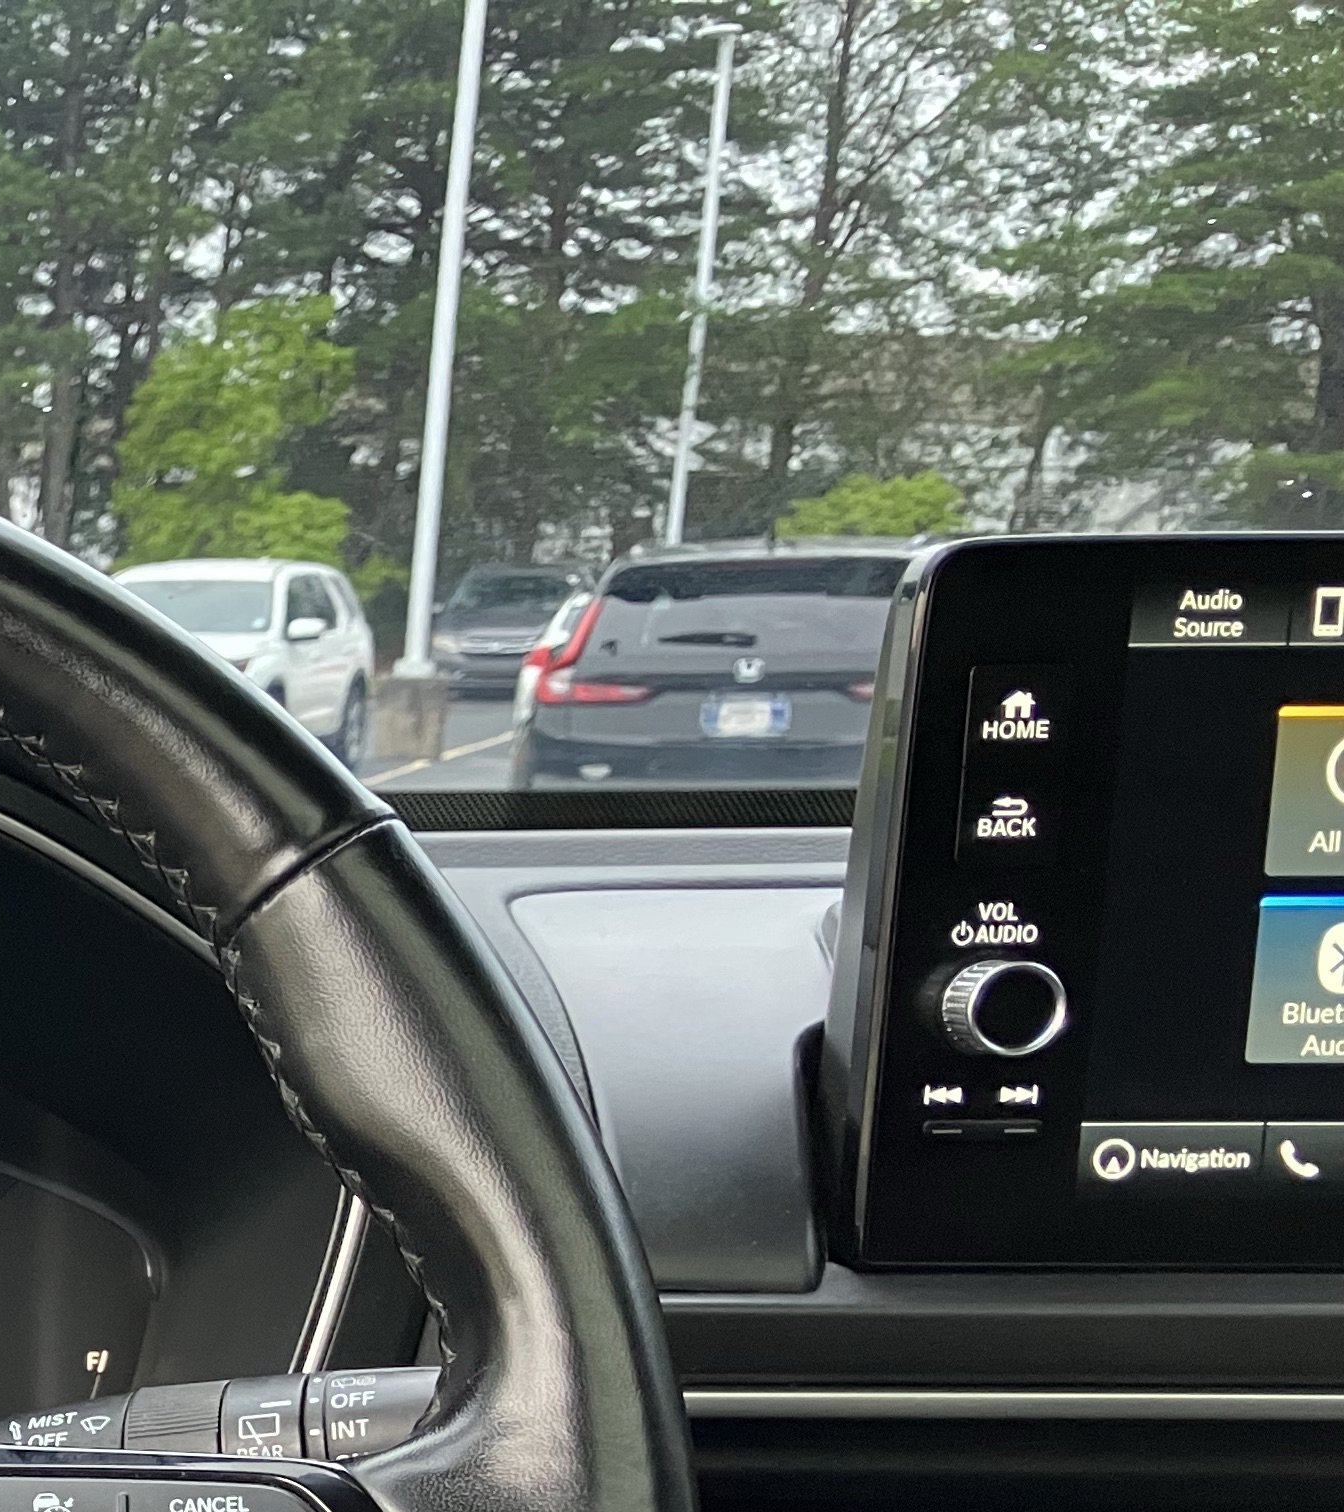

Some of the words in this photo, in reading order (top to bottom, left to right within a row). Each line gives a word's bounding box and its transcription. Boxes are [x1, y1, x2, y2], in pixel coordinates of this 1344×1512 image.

[1180, 589, 1243, 611] Audio
[1174, 616, 1244, 638] Source
[982, 719, 1050, 740] HOME
[976, 817, 1036, 838] BACK
[1309, 830, 1341, 852] All
[978, 902, 1018, 922] VOL
[975, 923, 1038, 944] AUDIO
[1141, 1149, 1250, 1172] Navigation
[86, 1351, 98, 1372] F
[330, 1390, 376, 1409] OFF
[27, 1411, 78, 1430] MIST
[330, 1418, 370, 1440] INT
